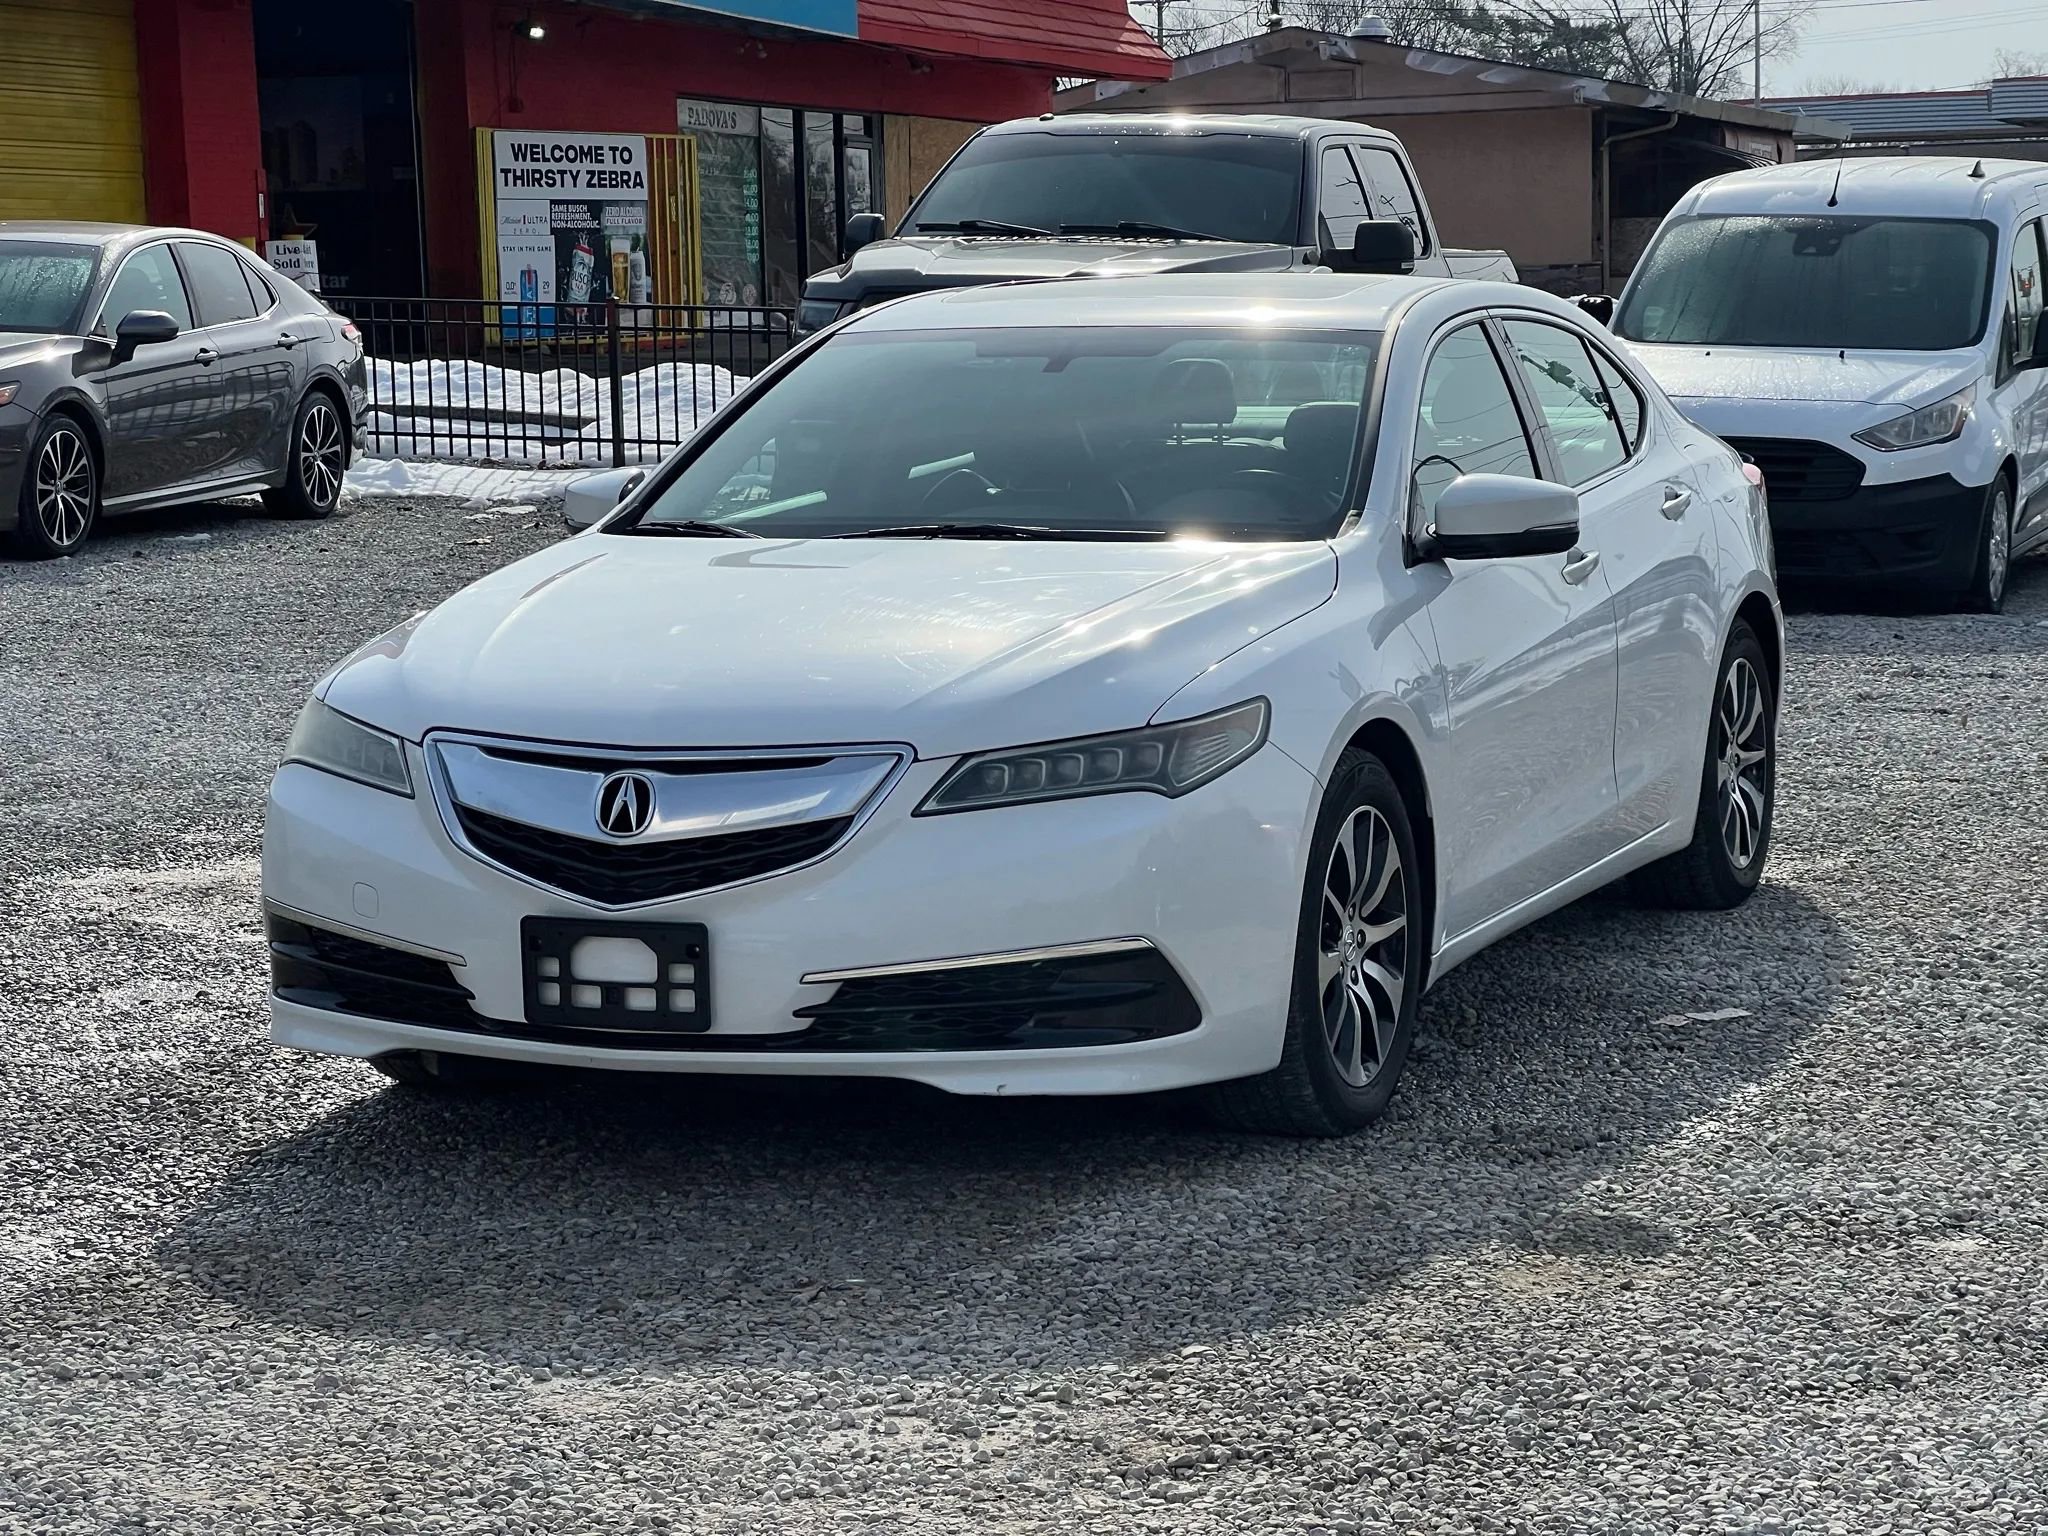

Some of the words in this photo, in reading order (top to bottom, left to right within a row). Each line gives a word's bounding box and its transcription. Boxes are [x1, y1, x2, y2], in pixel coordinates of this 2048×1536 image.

[687, 107, 737, 129] PADOVA'S
[510, 143, 605, 164] WELCOME
[608, 146, 633, 165] TO
[500, 168, 582, 188] THIRSTY
[586, 170, 644, 189] ZEBRA
[551, 204, 568, 213] SAME
[569, 205, 588, 213] BUSCH
[527, 216, 548, 225] ULTRA
[606, 217, 621, 225] FULL
[621, 217, 643, 225] FLAVOR
[276, 244, 301, 255] Live
[273, 258, 300, 270] Sold
